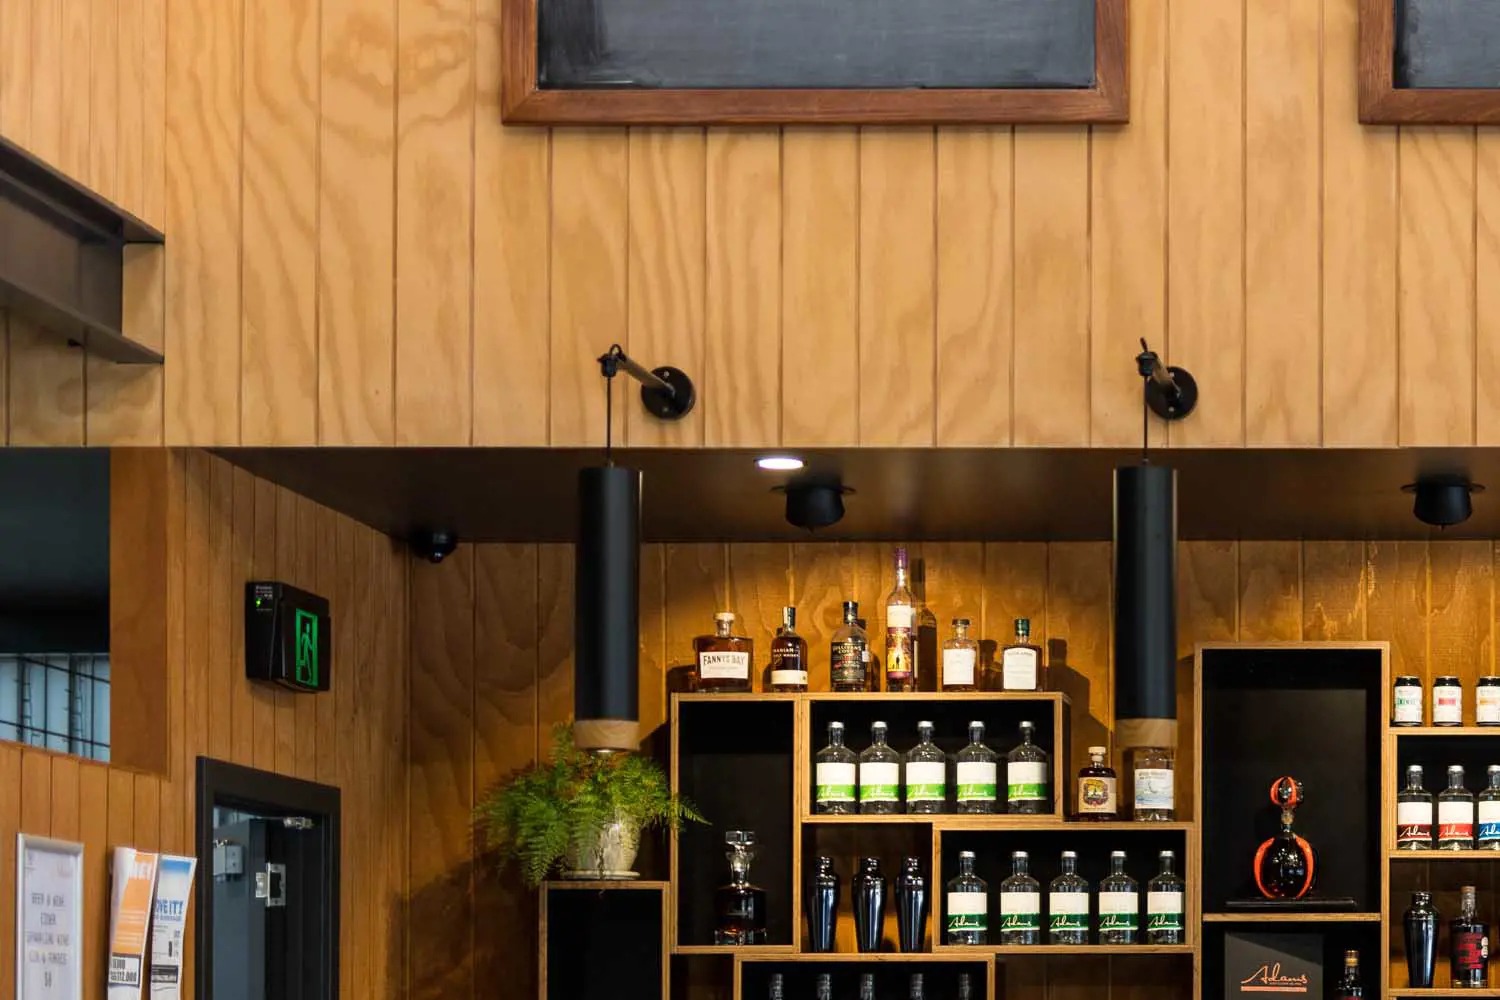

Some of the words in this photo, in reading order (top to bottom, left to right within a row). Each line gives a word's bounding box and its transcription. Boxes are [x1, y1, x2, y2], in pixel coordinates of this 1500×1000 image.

[1400, 825, 1430, 838] Adams
[949, 914, 980, 928] Adams
[1001, 914, 1032, 928] Adams
[1050, 914, 1081, 928] Adams
[1100, 914, 1131, 927] Adams
[1148, 914, 1180, 927] Adams
[1241, 962, 1308, 985] Adams
